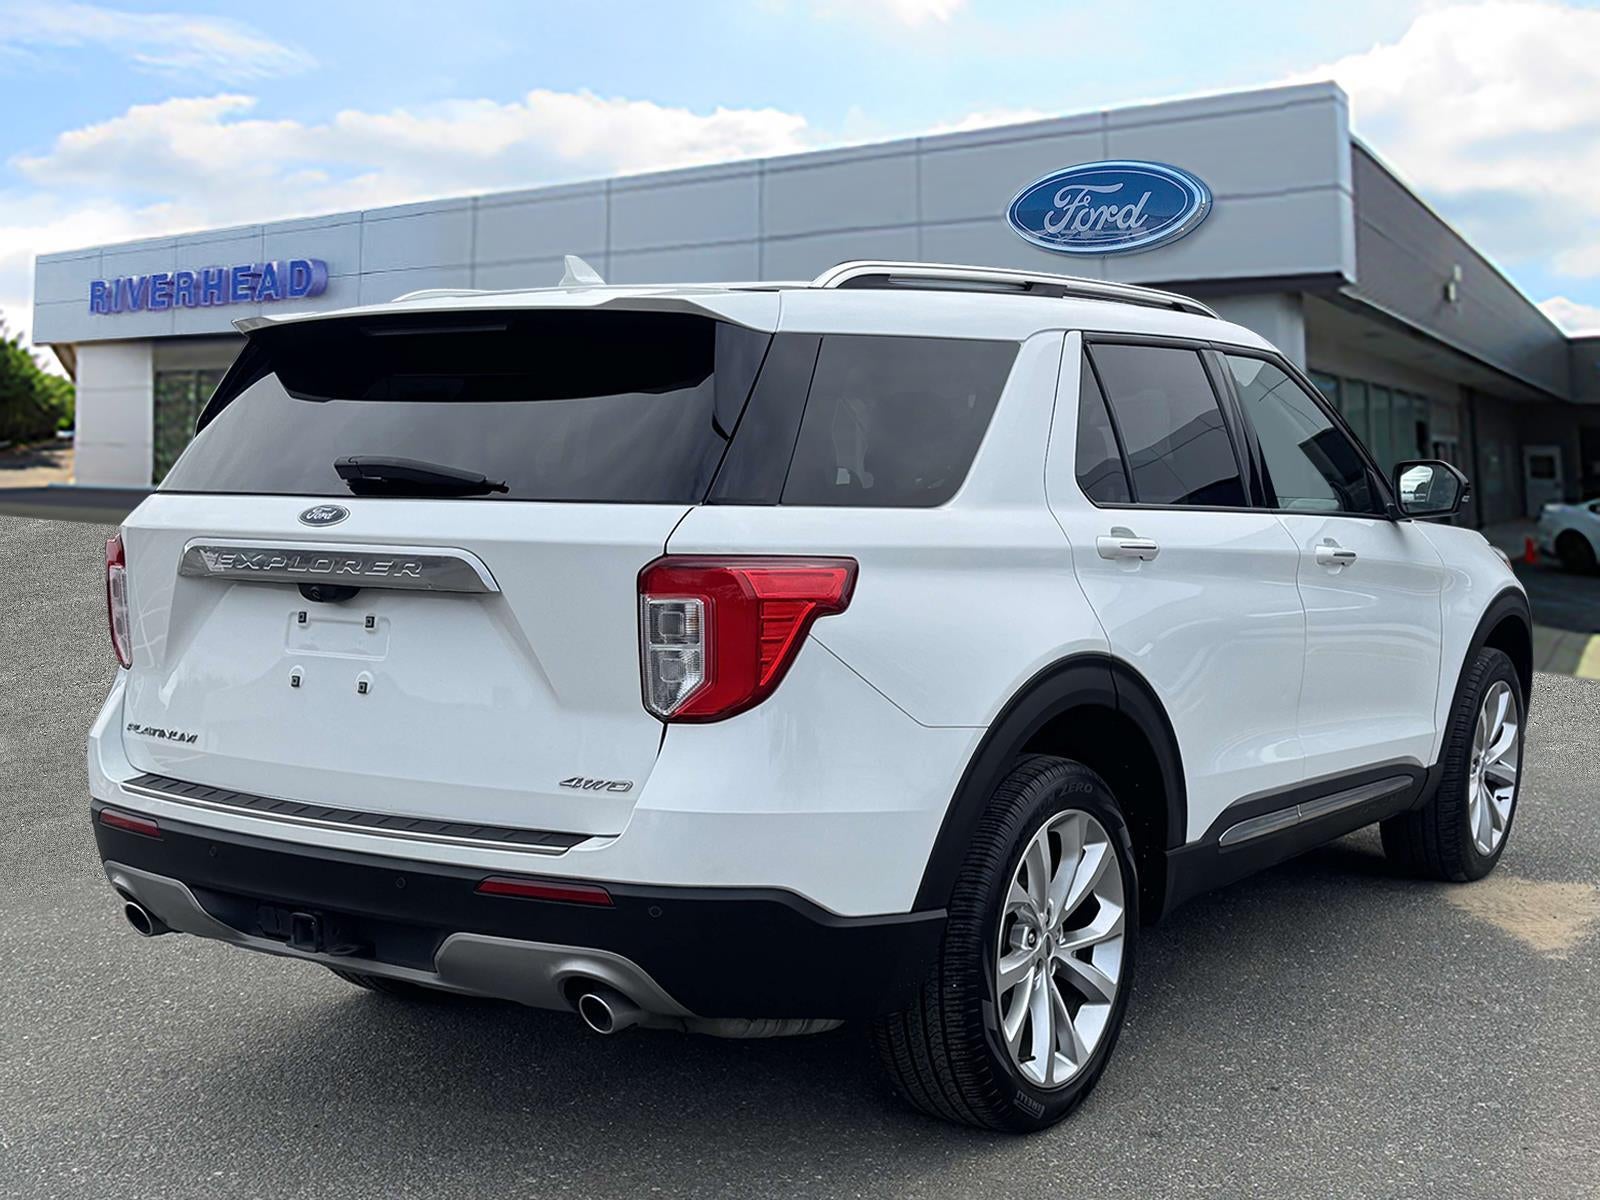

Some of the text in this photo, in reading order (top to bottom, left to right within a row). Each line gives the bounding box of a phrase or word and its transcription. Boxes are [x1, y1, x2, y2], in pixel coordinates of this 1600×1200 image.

[1043, 182, 1152, 234] Ford
[89, 258, 328, 314] RIVERHEAD
[215, 553, 423, 578] EXPLORER
[126, 723, 198, 744] PLATINUM
[559, 776, 634, 793] 4WD
[1060, 783, 1094, 797] ZERO
